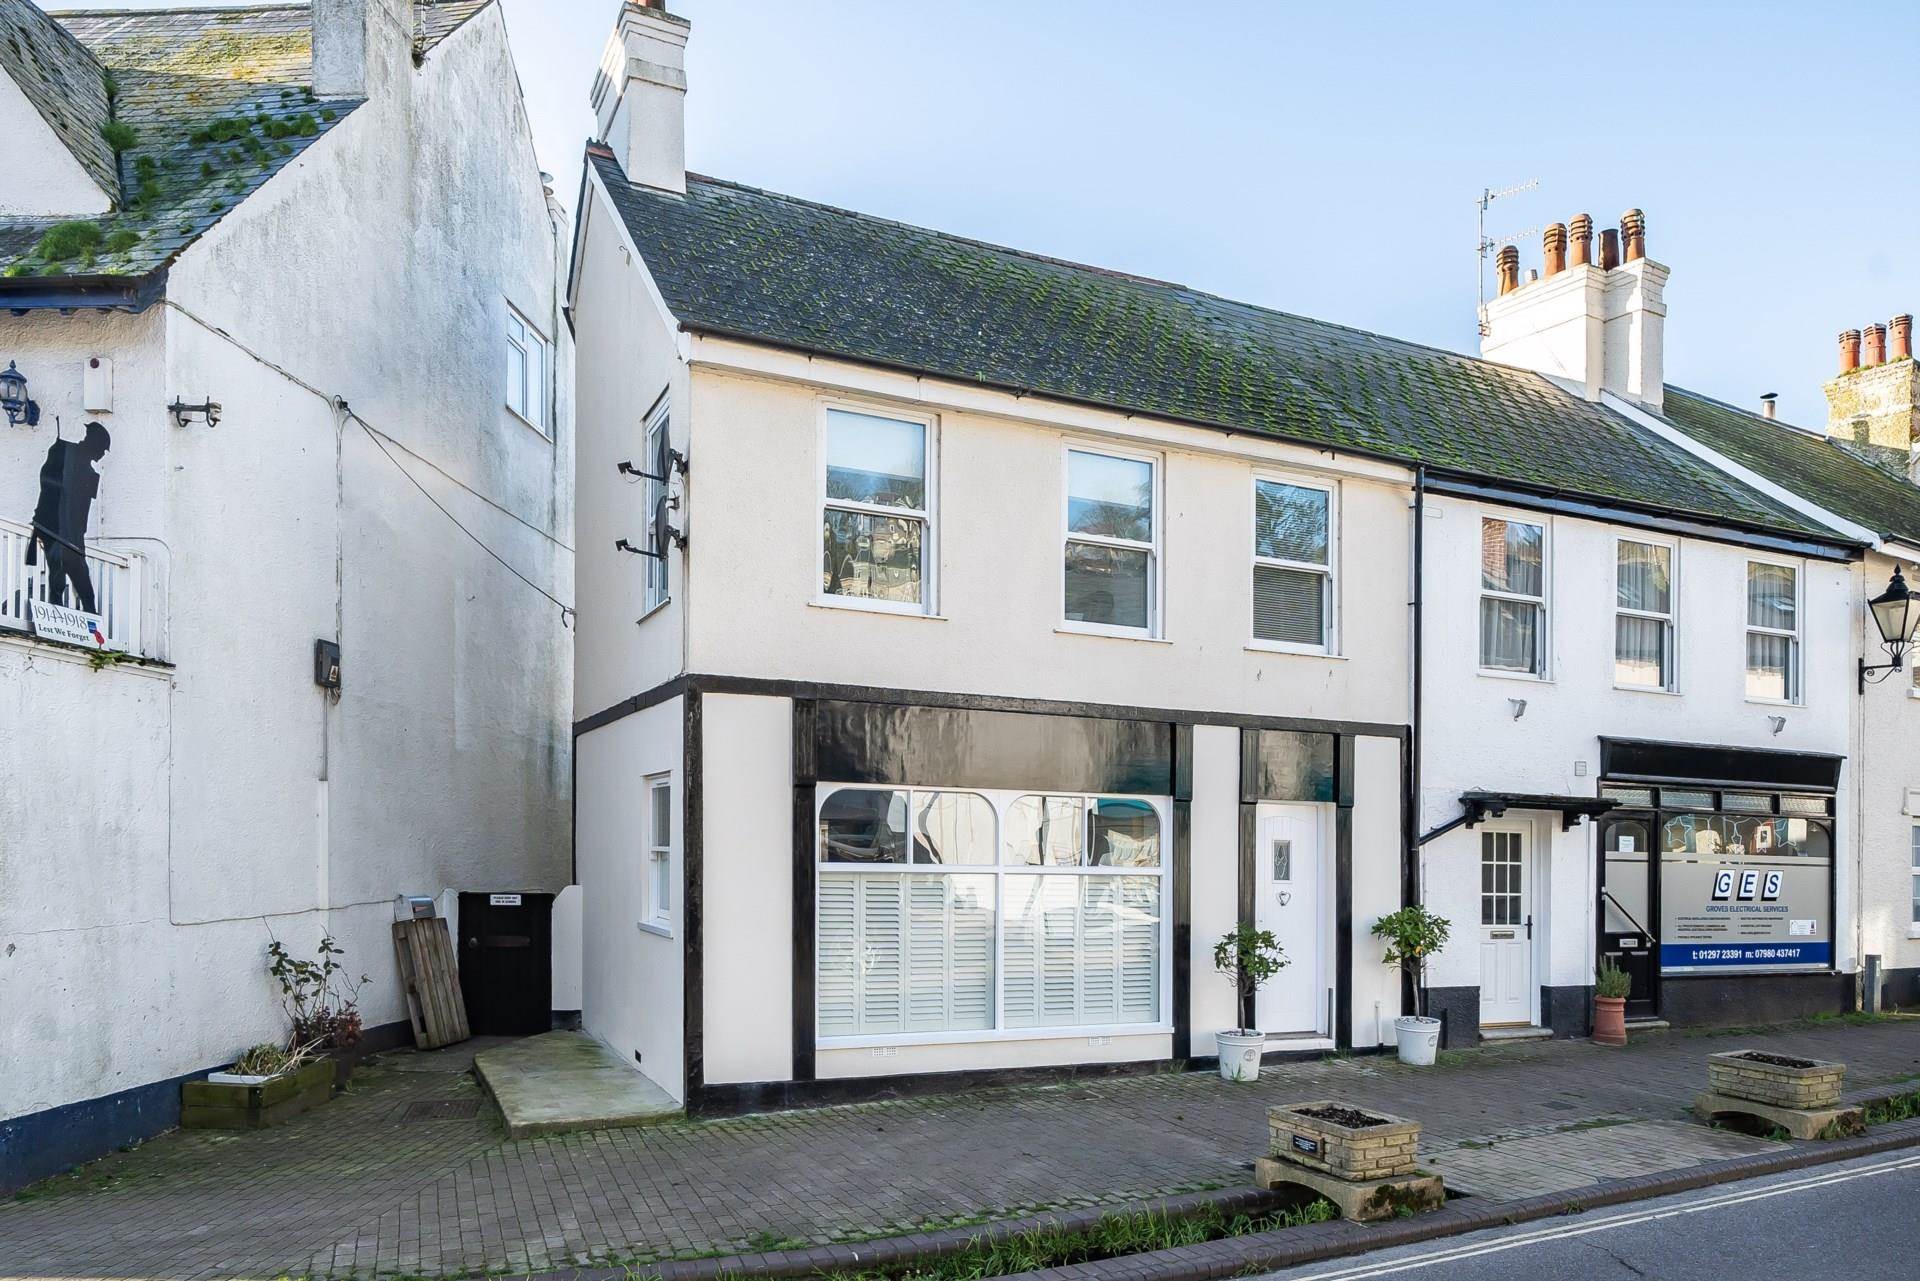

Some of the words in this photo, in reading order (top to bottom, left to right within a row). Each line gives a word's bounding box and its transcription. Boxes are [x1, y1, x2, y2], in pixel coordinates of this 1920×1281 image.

[38, 624, 53, 634] Lest
[54, 627, 66, 637] We
[67, 631, 90, 641] Forget
[1706, 905, 1728, 913] GROVES
[1729, 905, 1762, 913] ELECTRICAL
[1763, 905, 1789, 913] SERVICES
[1699, 950, 1720, 960] 01297
[1722, 949, 1742, 959] 23391
[1745, 950, 1754, 958] m:
[1776, 948, 1800, 958] 437417
